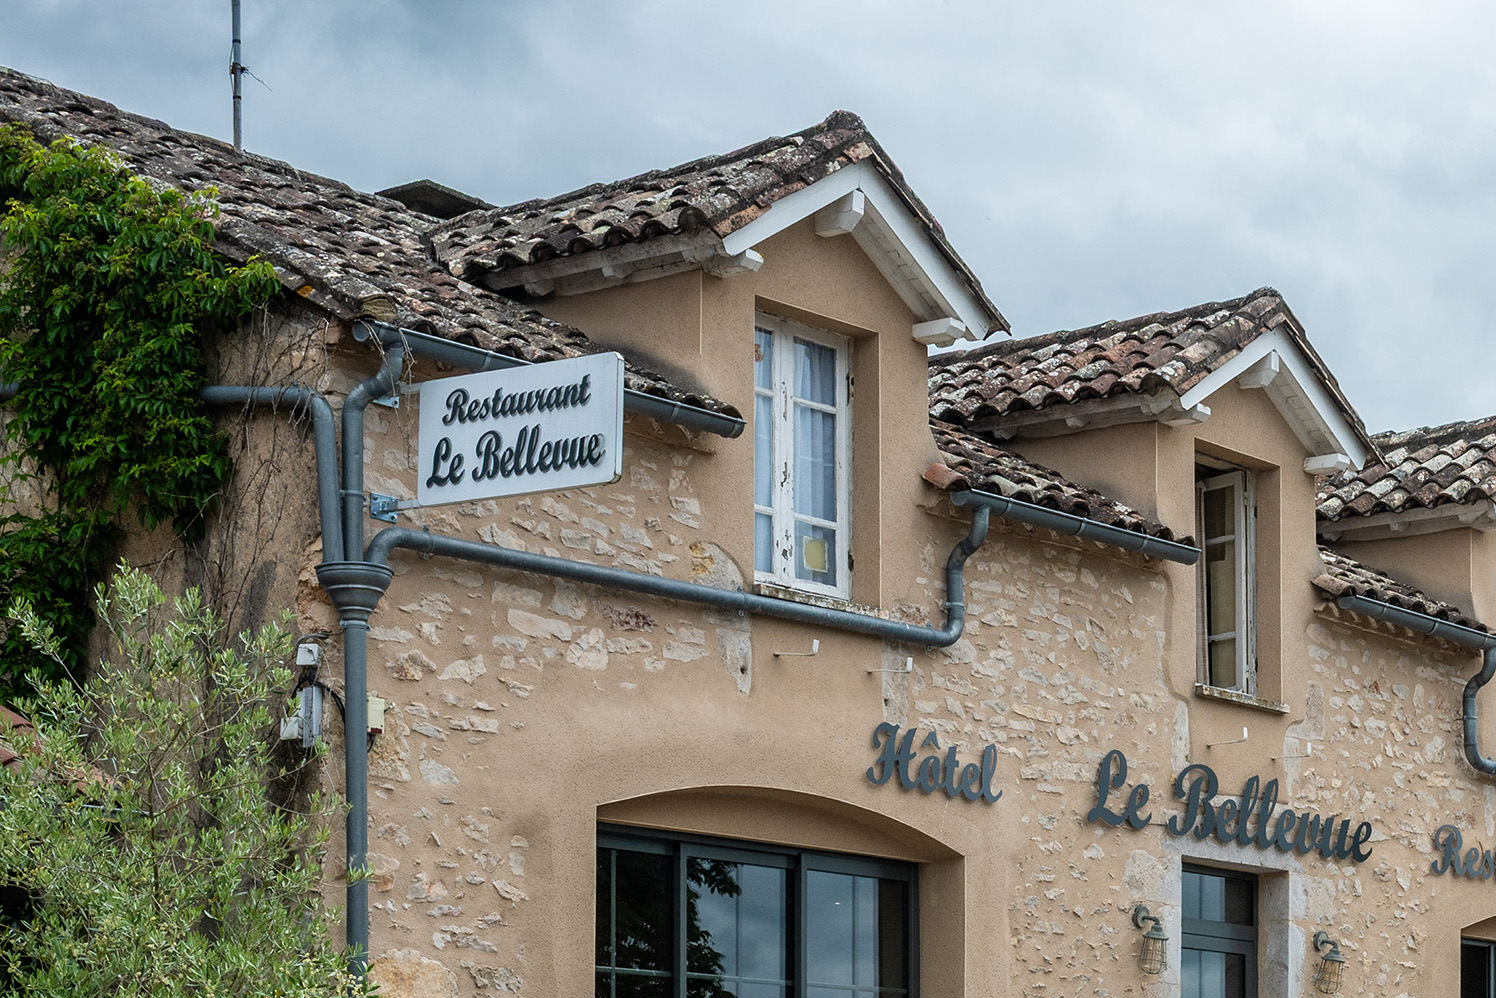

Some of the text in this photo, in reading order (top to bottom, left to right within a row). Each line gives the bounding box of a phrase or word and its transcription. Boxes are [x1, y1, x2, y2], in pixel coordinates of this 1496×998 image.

[442, 373, 592, 426] Restaurant
[425, 423, 607, 489] Le Bellevue
[865, 721, 1003, 804] Hôtel
[1087, 749, 1374, 863] Le Bellevue
